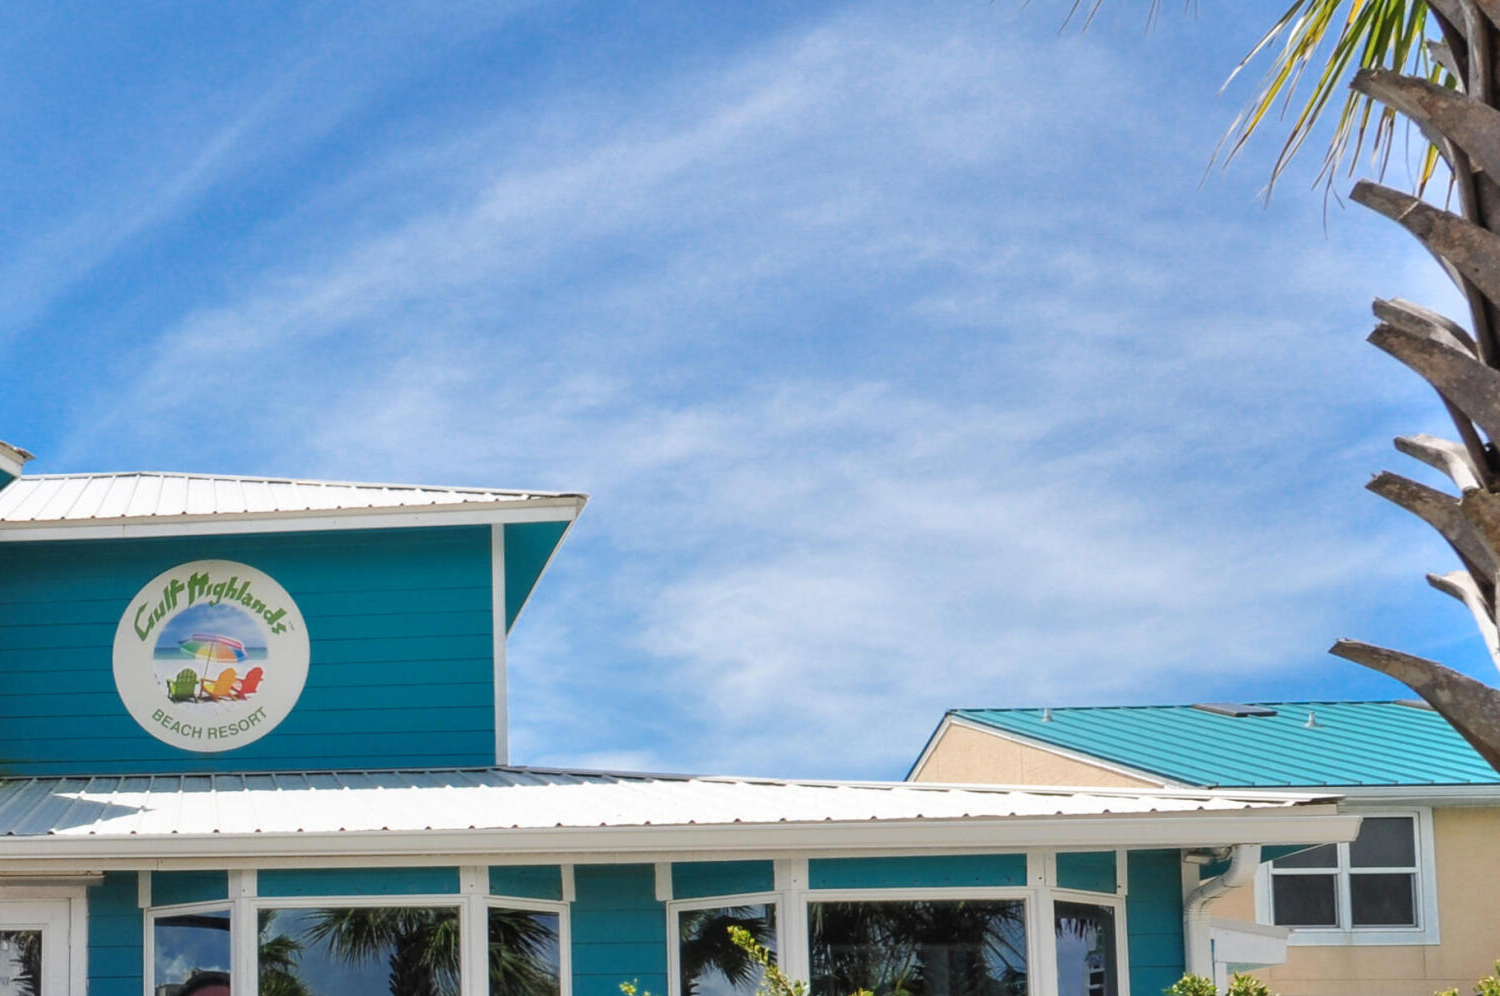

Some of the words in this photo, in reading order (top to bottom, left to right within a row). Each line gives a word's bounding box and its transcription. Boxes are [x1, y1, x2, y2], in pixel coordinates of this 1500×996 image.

[134, 579, 185, 642] Gulf
[187, 572, 288, 635] Highlands
[152, 709, 203, 739] BEACH
[207, 706, 267, 740] RESORT
